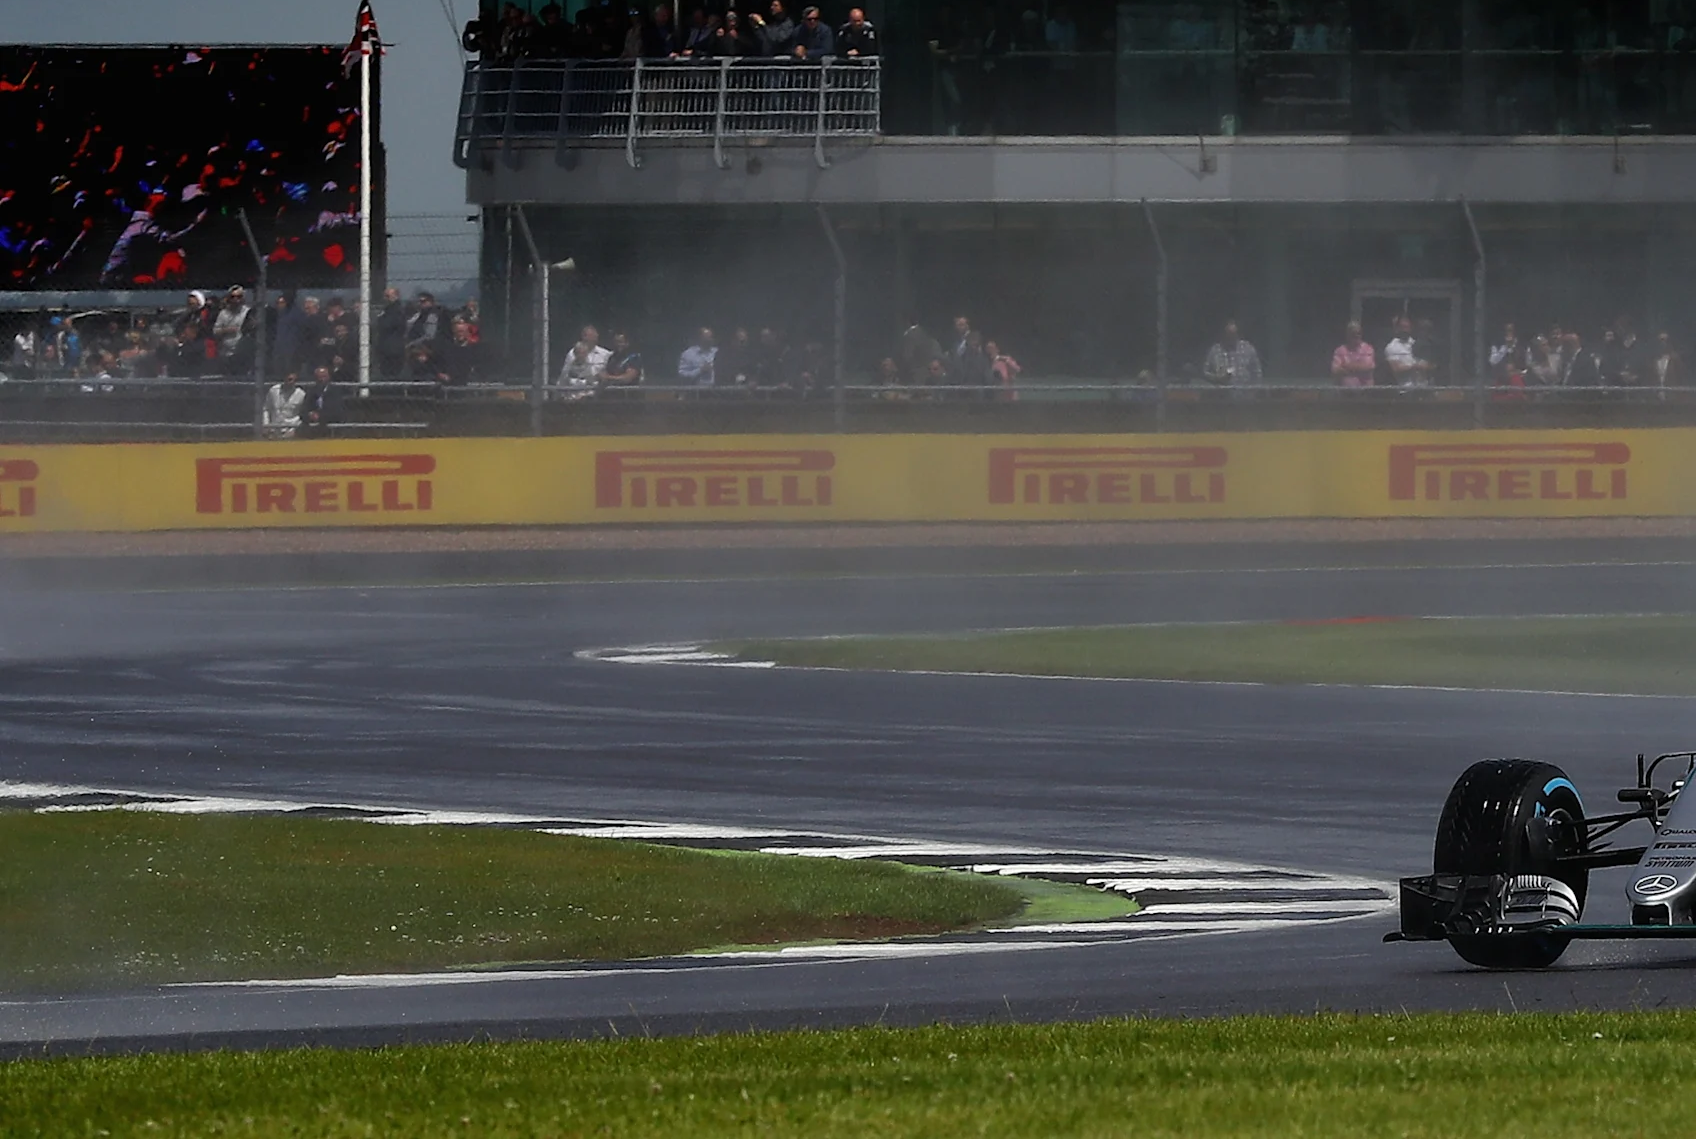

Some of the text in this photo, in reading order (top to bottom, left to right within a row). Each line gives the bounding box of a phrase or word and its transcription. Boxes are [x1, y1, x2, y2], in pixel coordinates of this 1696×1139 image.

[196, 454, 436, 514] PIRELLI
[595, 450, 836, 510] PIRELLI
[988, 446, 1228, 505] PIRELLI
[1388, 442, 1631, 500] PIRELLI
